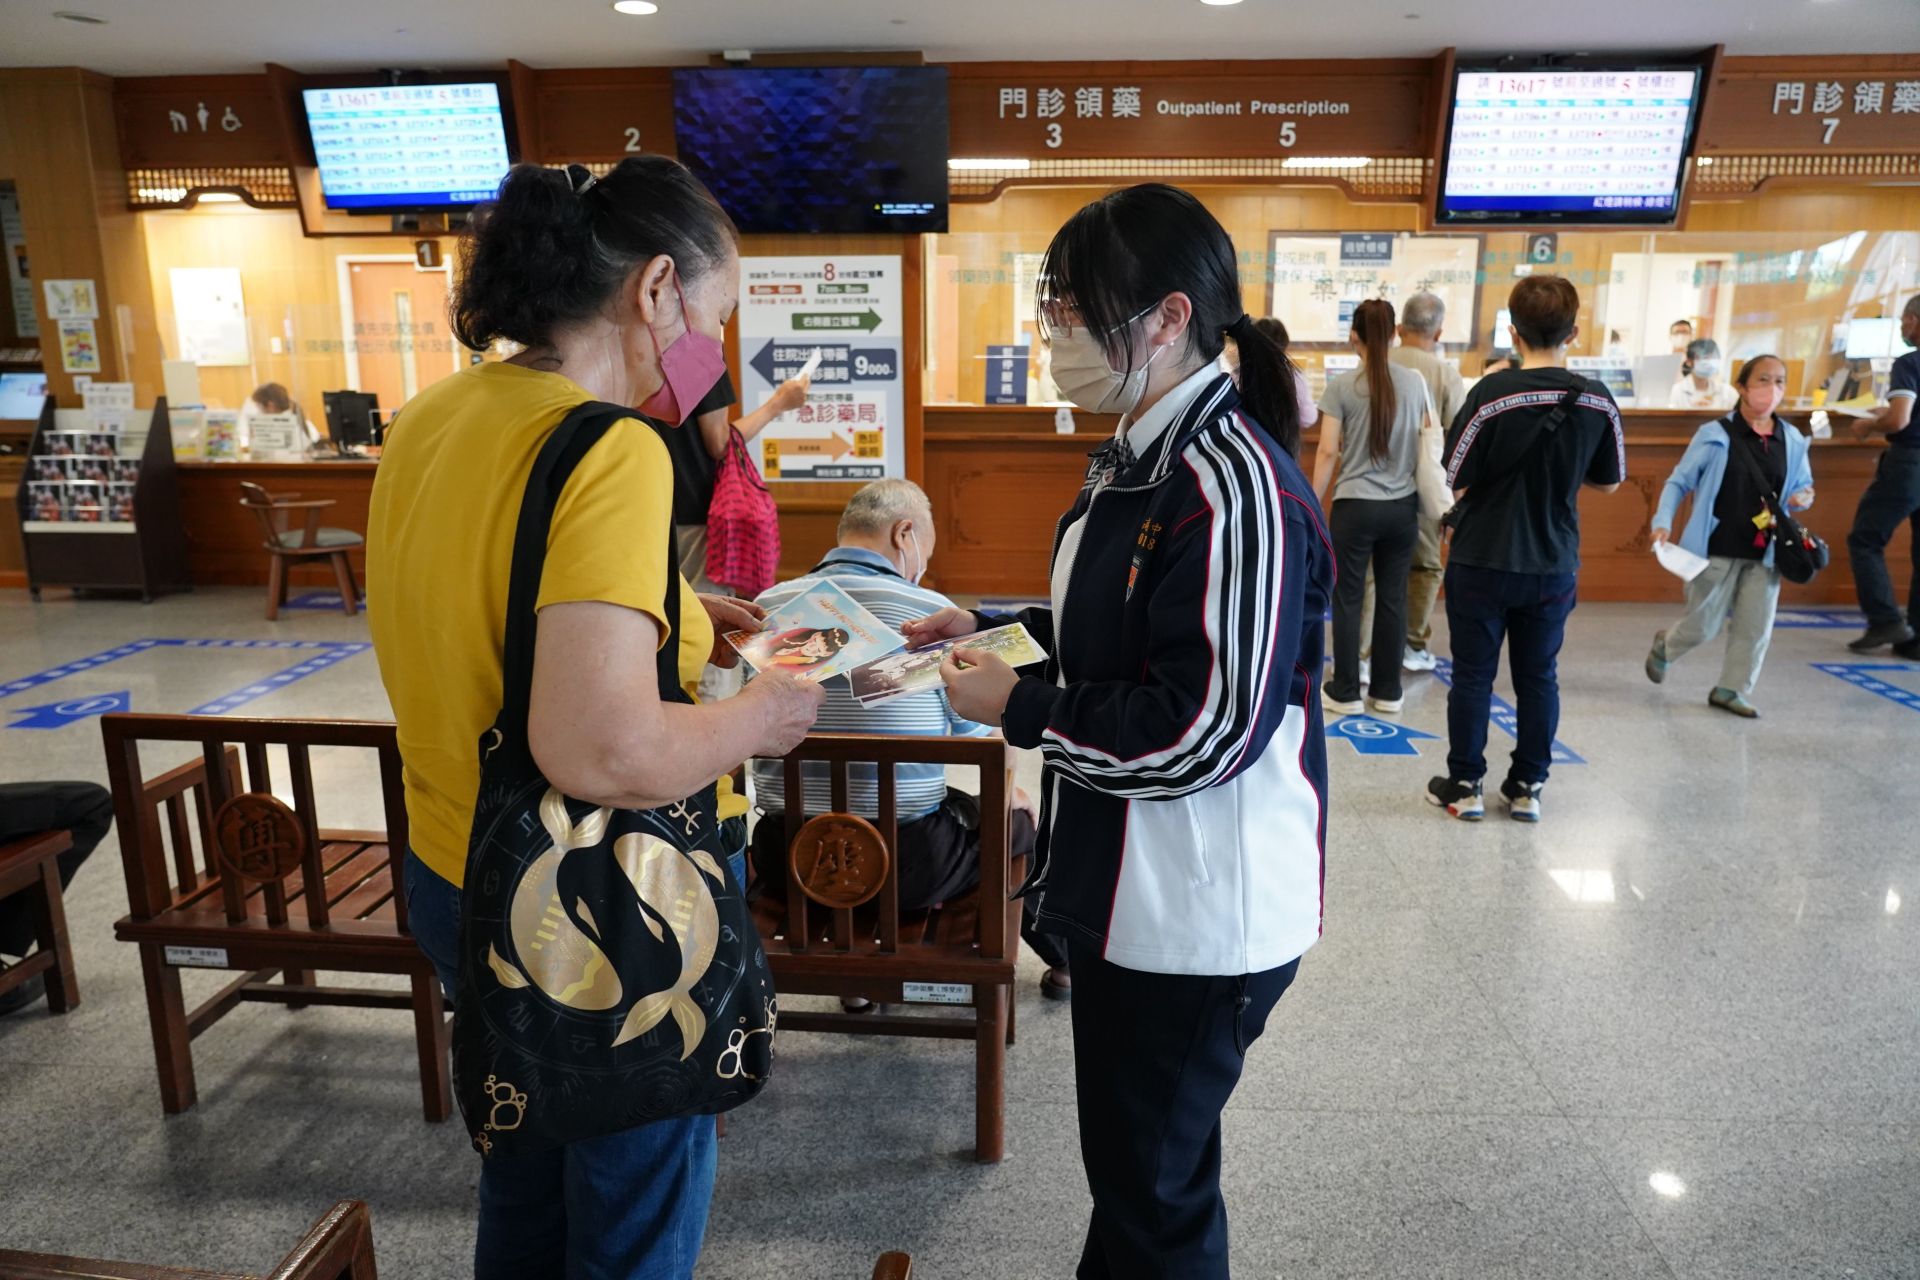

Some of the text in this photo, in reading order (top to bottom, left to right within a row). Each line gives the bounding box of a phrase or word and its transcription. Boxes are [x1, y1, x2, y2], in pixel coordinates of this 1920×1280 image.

[1498, 79, 1547, 95] 13617
[1621, 79, 1632, 95] 5
[1772, 81, 1920, 115] 門診領藥
[1000, 87, 1349, 119] 門診領藥 Outpatient Prescription
[624, 127, 641, 152] 2
[1045, 123, 1063, 148] 3
[1279, 122, 1298, 148] 5
[1822, 118, 1840, 144] 7
[420, 242, 432, 266] 1
[1533, 237, 1551, 261] 6
[824, 262, 835, 281] 8
[773, 366, 849, 381] 請至診藥局
[1357, 721, 1384, 736] 5
